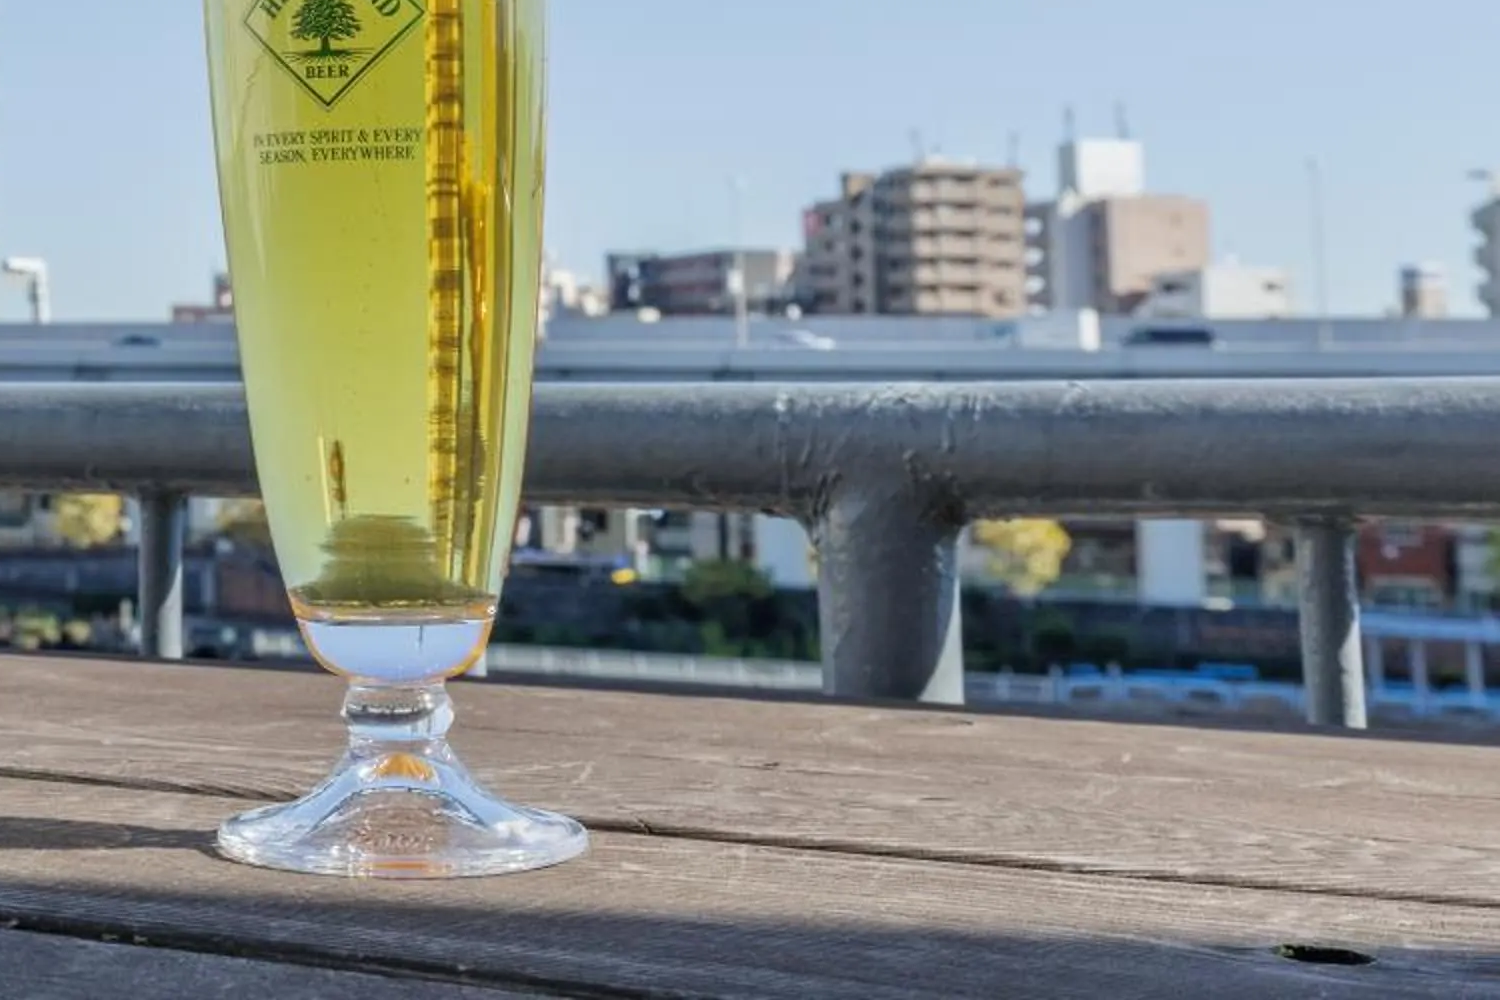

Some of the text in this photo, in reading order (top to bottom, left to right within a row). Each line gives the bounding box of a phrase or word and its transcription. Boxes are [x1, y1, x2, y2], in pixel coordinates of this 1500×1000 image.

[305, 64, 350, 79] BEER
[309, 128, 353, 145] SPIRIT
[357, 128, 369, 144] &
[373, 126, 422, 142] EVERY
